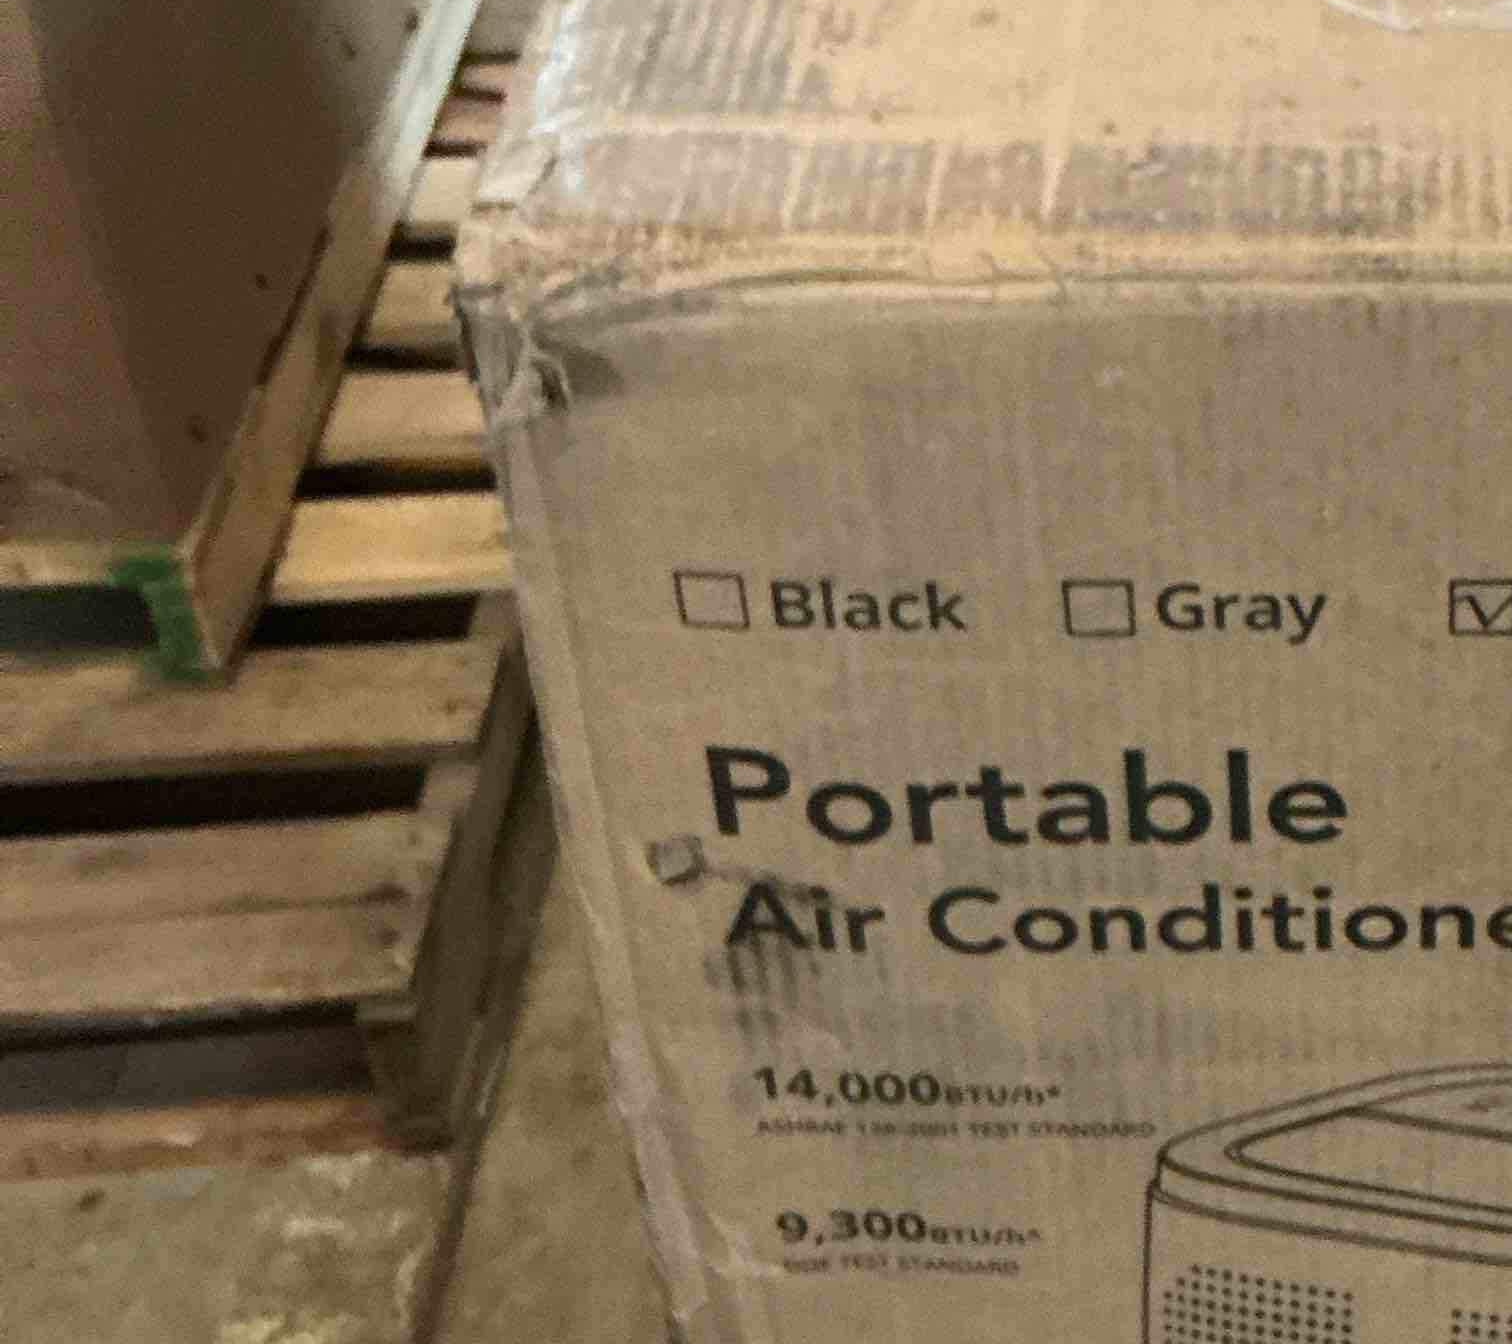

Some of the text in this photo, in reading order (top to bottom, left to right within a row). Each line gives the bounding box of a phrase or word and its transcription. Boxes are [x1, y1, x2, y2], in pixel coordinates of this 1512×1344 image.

[770, 576, 968, 632] Black
[1156, 581, 1327, 646] Gray
[703, 743, 1350, 848] Portable
[724, 881, 887, 953] Air
